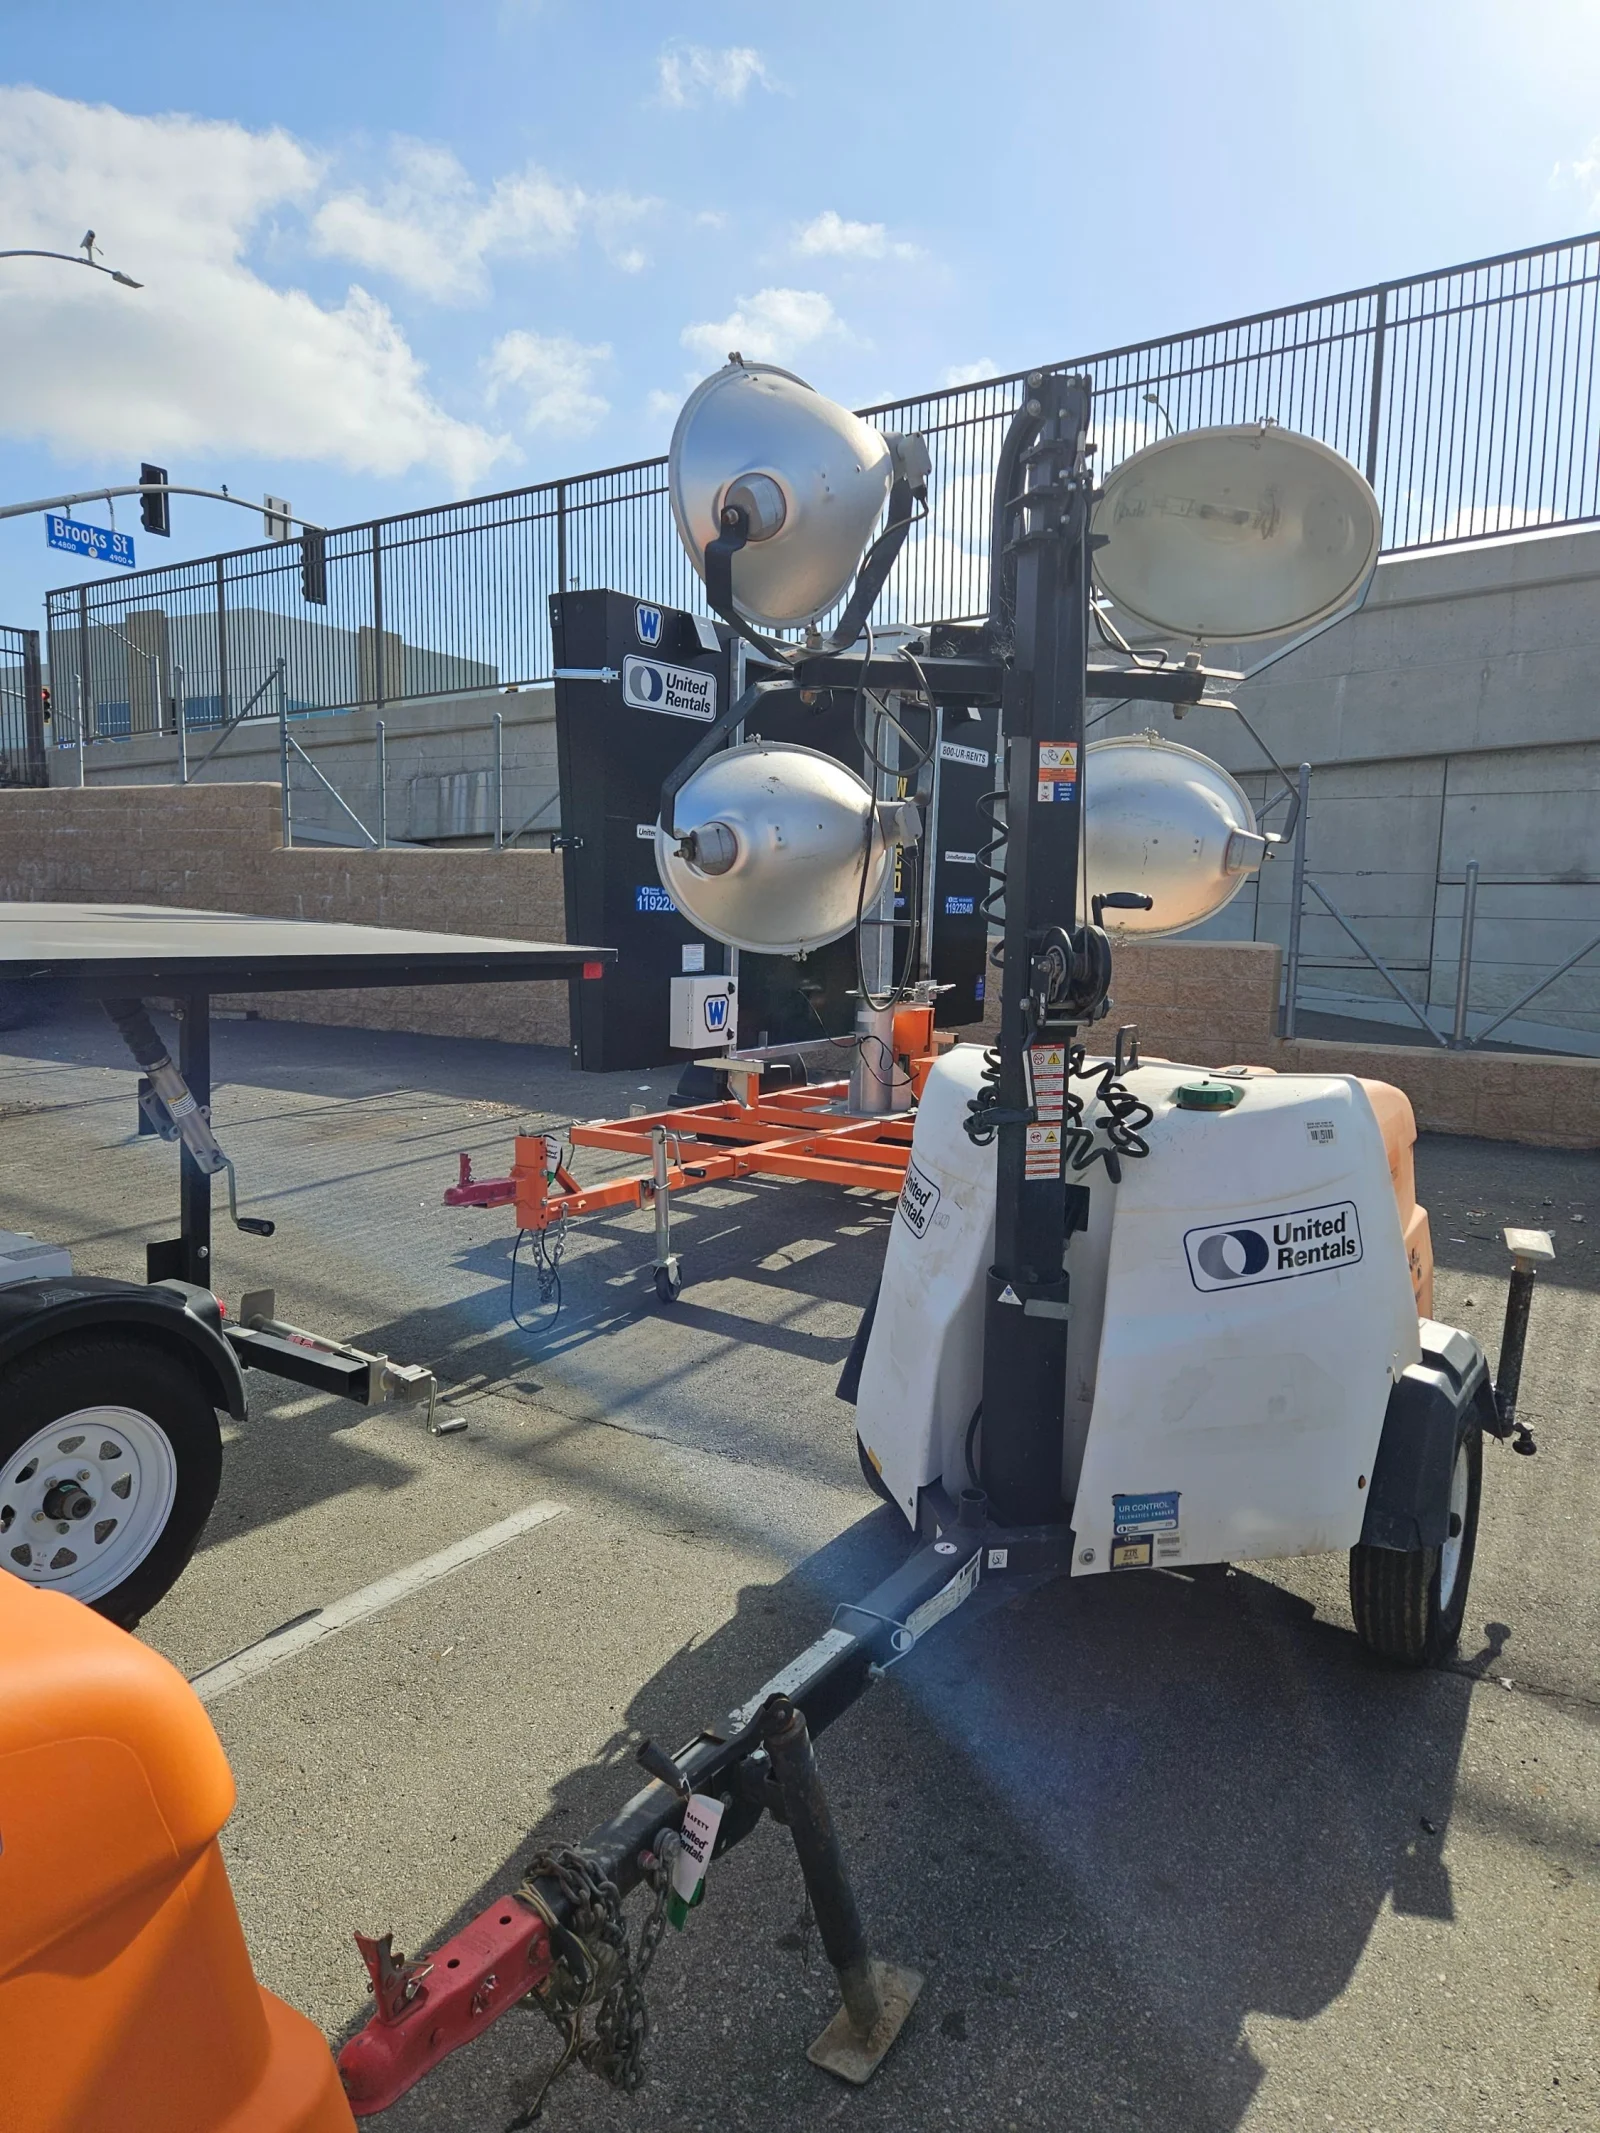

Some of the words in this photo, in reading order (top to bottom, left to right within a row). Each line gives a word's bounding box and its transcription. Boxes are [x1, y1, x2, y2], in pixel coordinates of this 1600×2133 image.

[53, 517, 107, 549] Brooks
[112, 534, 128, 554] St
[57, 540, 77, 551] 4800
[109, 554, 127, 564] 4900
[639, 608, 659, 639] W
[666, 672, 708, 696] United
[665, 689, 711, 713] Rentals
[942, 745, 986, 764] 800-UR-RENTS
[707, 1001, 726, 1026] W
[1273, 1210, 1346, 1246] United
[1277, 1234, 1356, 1270] Rentals
[1118, 1505, 1131, 1513] UR
[1131, 1501, 1170, 1512] CONTROL
[1118, 1512, 1150, 1520] TELEMATICS
[1151, 1509, 1175, 1517] ENABLED
[687, 1811, 709, 1831] SAFETY
[680, 1839, 704, 1863] entals
